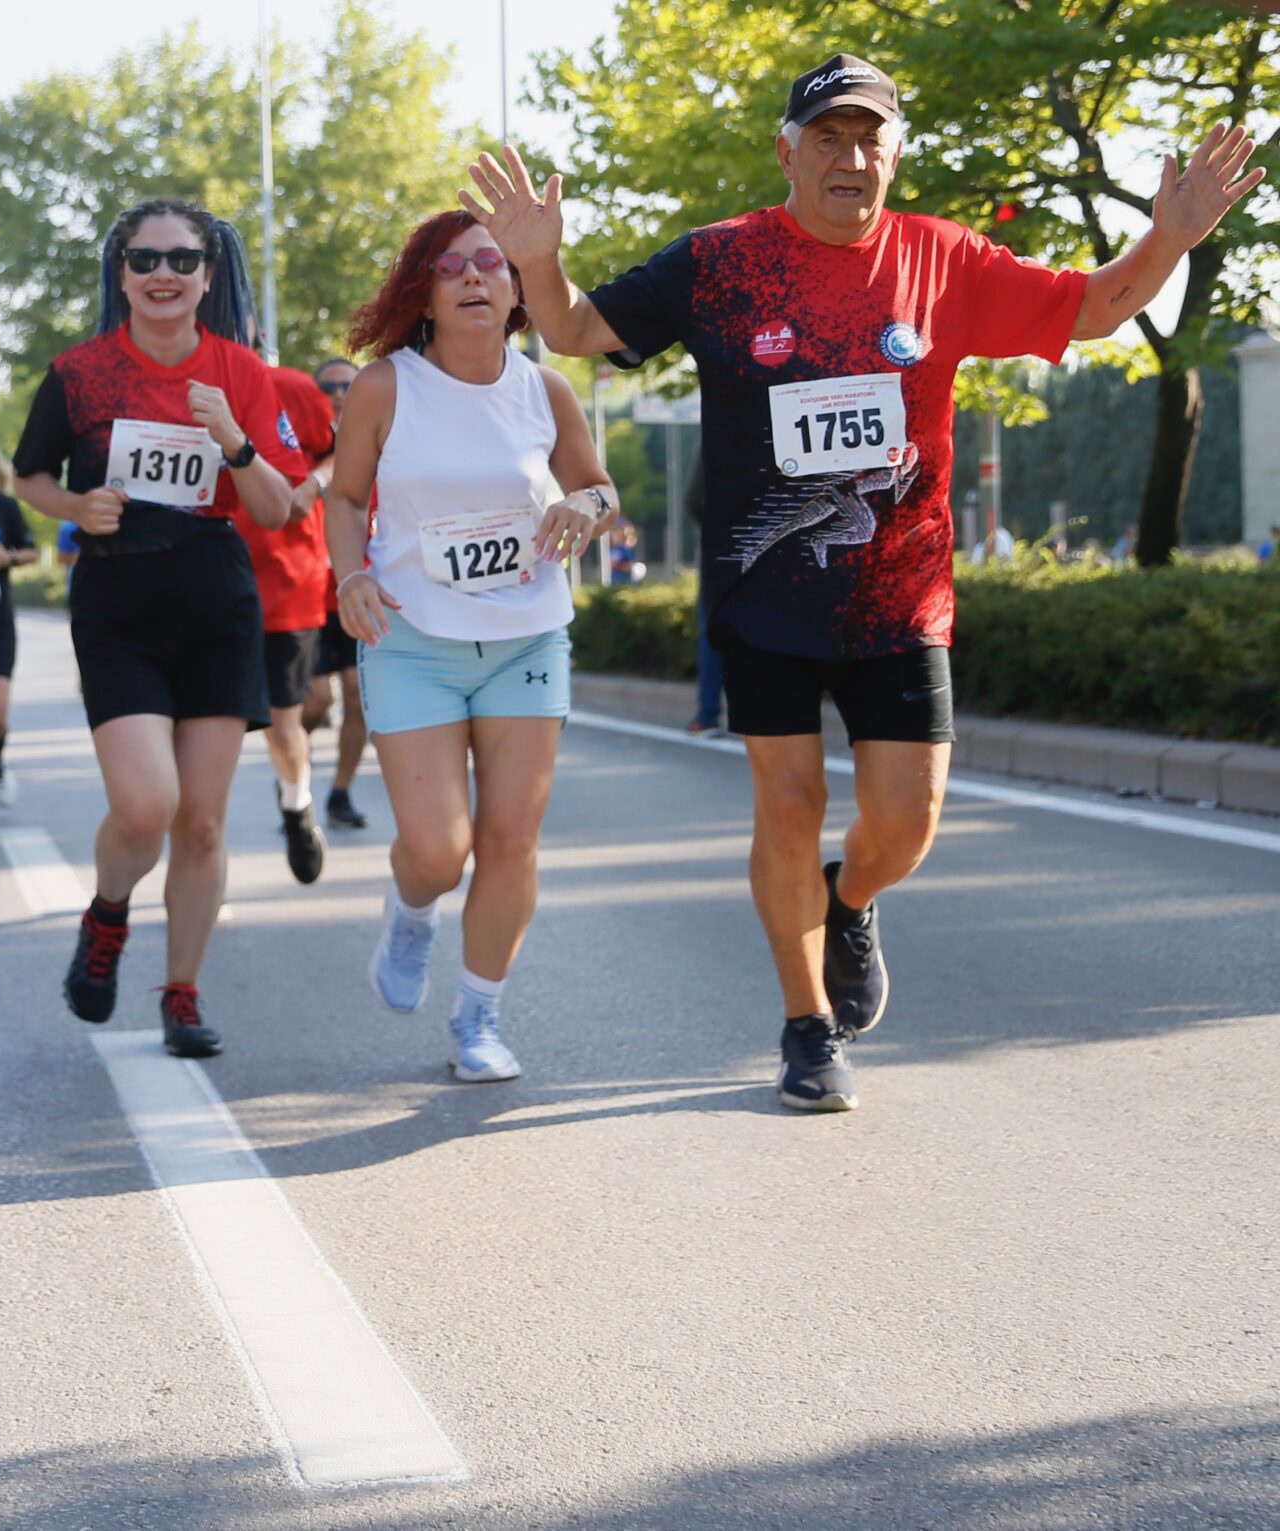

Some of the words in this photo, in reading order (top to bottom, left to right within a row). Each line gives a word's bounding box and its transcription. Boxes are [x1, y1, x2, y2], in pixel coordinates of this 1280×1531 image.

[794, 407, 884, 454] 1755
[129, 448, 203, 486] 1310
[443, 536, 520, 581] 1222
